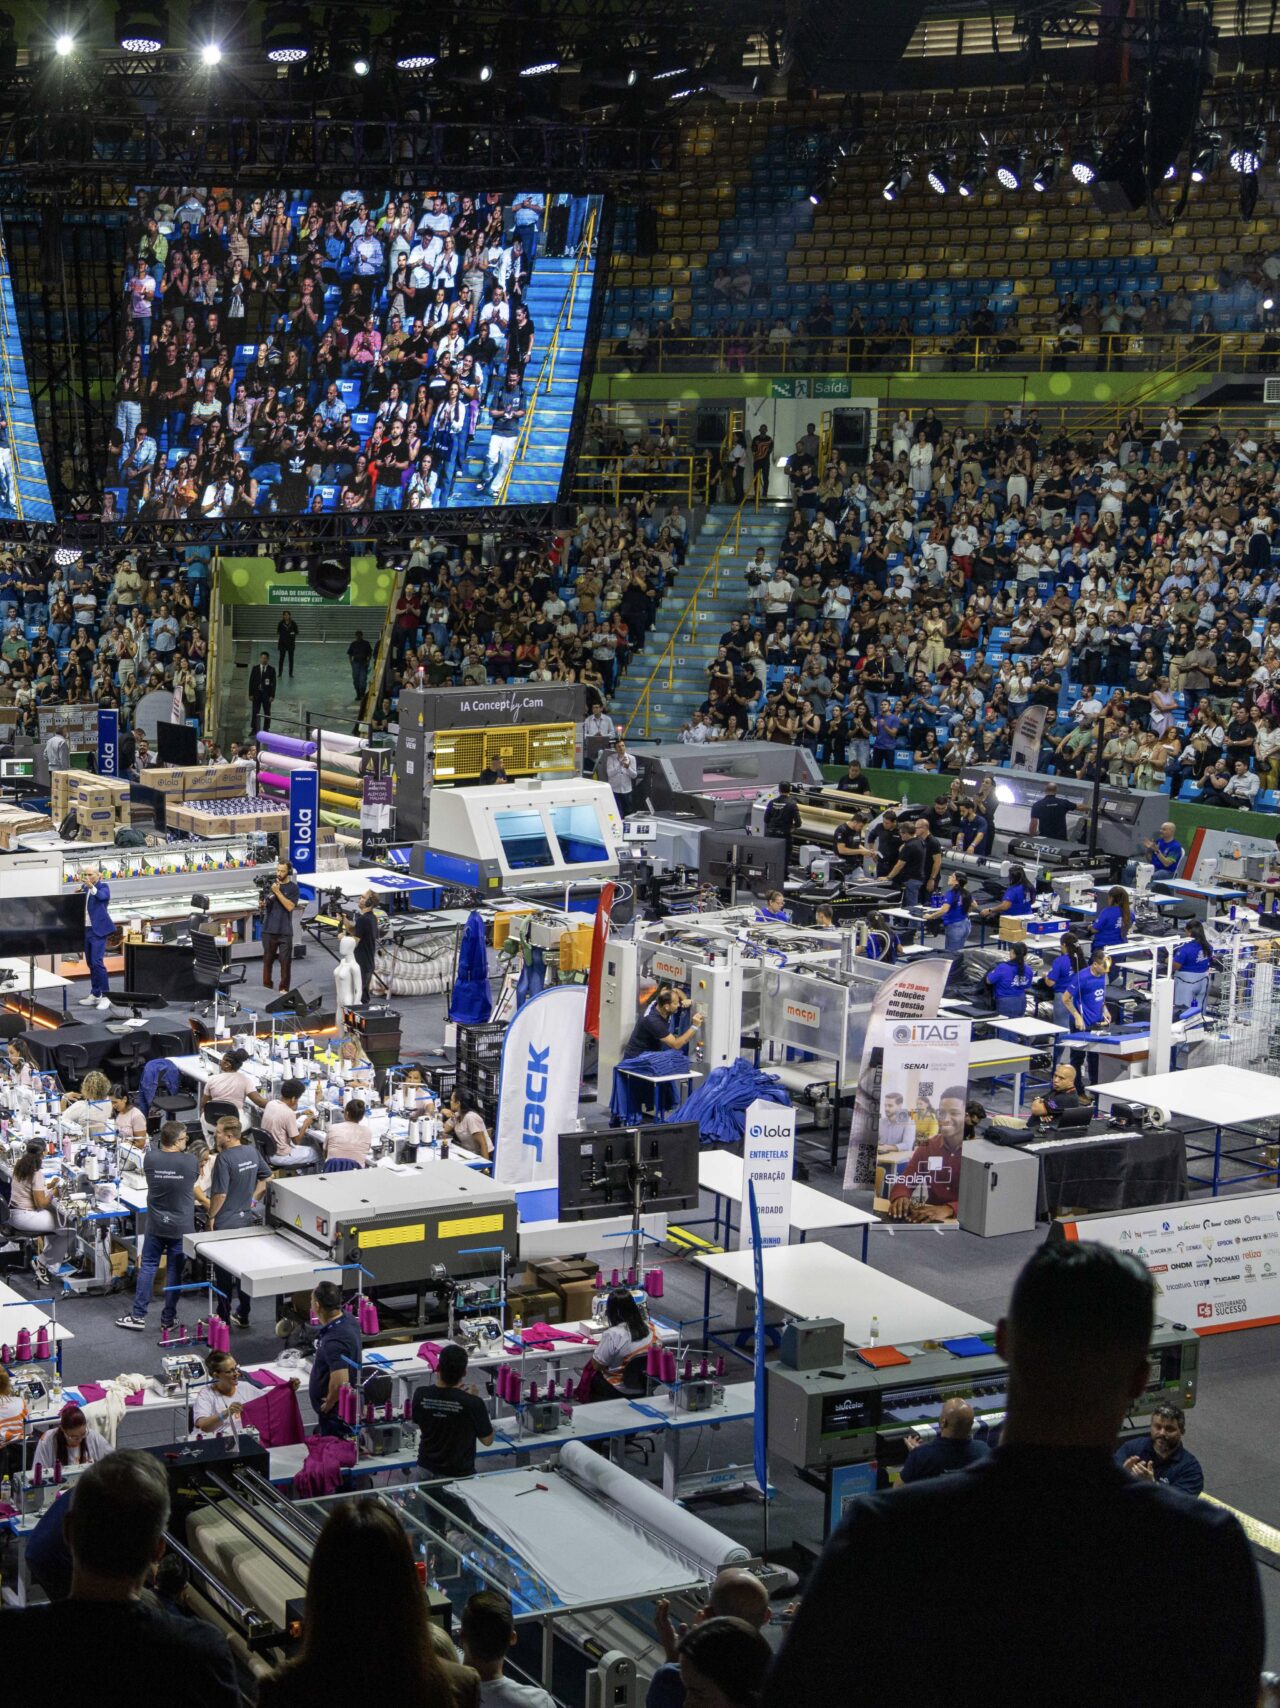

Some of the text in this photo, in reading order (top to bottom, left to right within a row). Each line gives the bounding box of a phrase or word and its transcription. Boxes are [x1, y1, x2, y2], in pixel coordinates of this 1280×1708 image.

[815, 382, 849, 393] Saída
[272, 588, 288, 596] SAÍDA
[460, 692, 544, 723] IA Concept by Cam
[101, 743, 114, 773] lola
[294, 809, 312, 844] lola
[656, 961, 683, 977] macpi
[893, 989, 925, 1001] Soluções
[900, 1000, 925, 1011] gestão
[787, 1005, 816, 1022] macpi
[912, 1025, 959, 1041] iTAG
[764, 1125, 791, 1138] lola
[749, 1150, 788, 1159] ENTRETELAS
[750, 1170, 786, 1183] FORRAÇÃO
[885, 1172, 932, 1186] Sisplan
[757, 1205, 784, 1215] ORDADO
[1177, 1221, 1200, 1232] bluecolor
[1217, 1239, 1233, 1247] EPSON
[1214, 1254, 1239, 1264] PROMAXI
[1170, 1261, 1192, 1270] ONDM
[1214, 1299, 1246, 1309] COSTURANDO
[1215, 1304, 1247, 1316] SUCESSO
[834, 1400, 864, 1412] bluecolor
